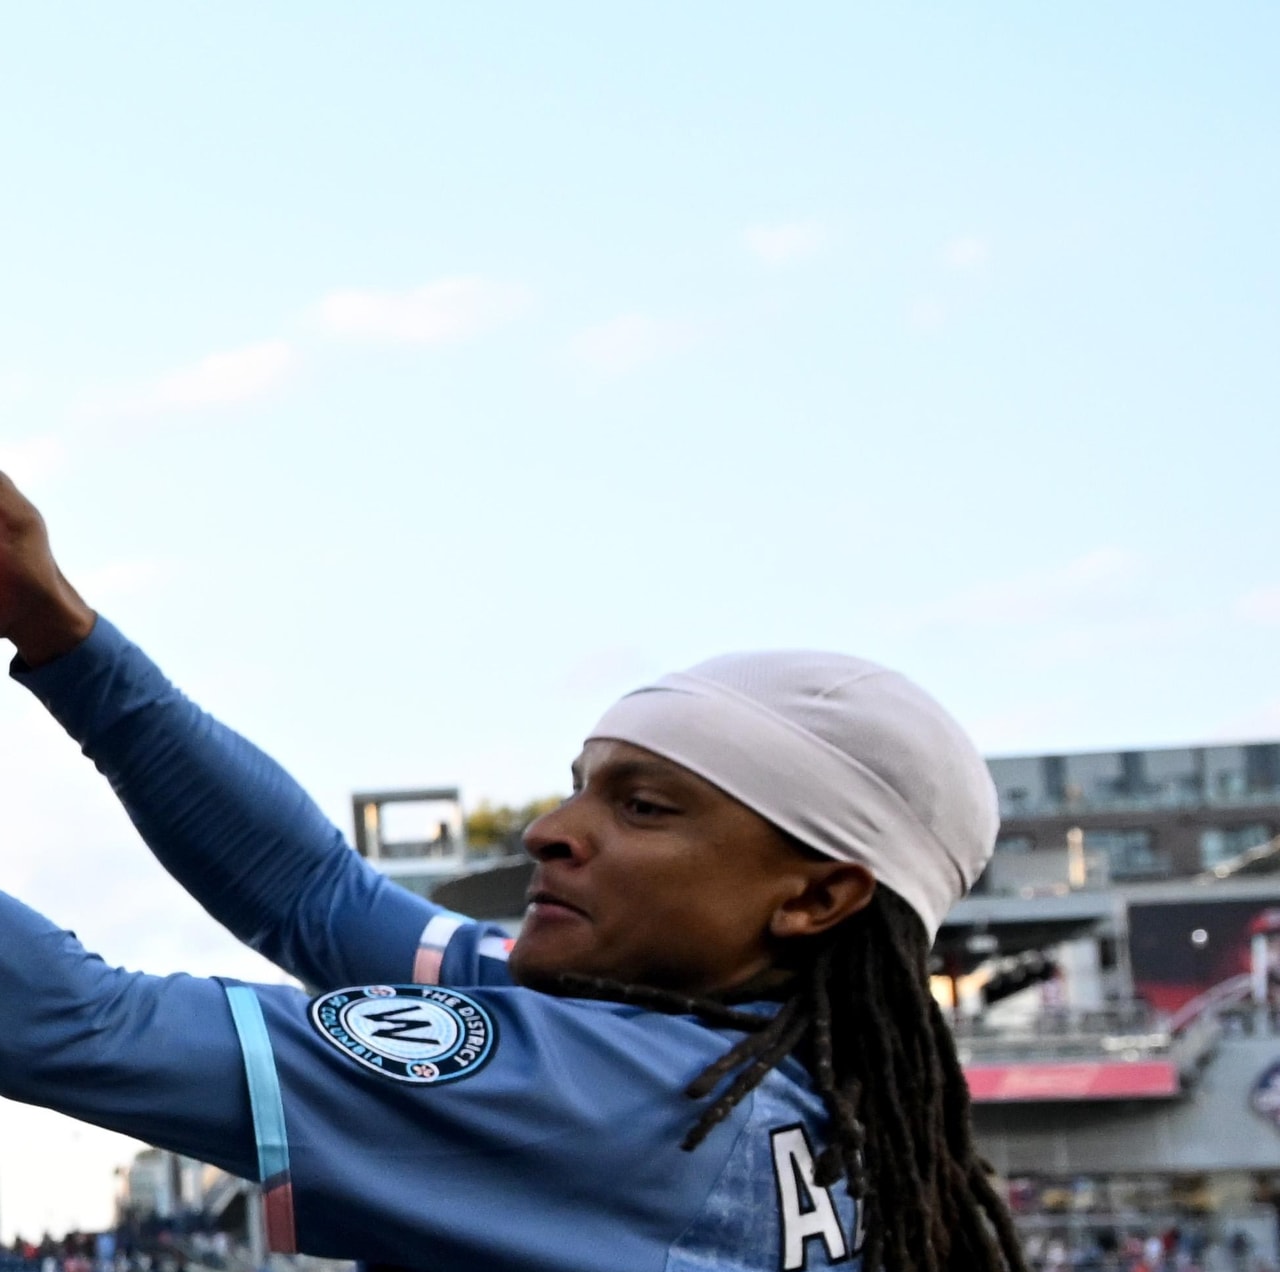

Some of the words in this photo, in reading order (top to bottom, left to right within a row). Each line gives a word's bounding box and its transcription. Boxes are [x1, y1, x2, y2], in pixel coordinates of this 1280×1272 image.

[321, 1006, 384, 1067] COLUMBIA
[363, 1005, 441, 1045] W
[421, 989, 461, 1006] THE
[453, 1005, 486, 1068] DISTRICT
